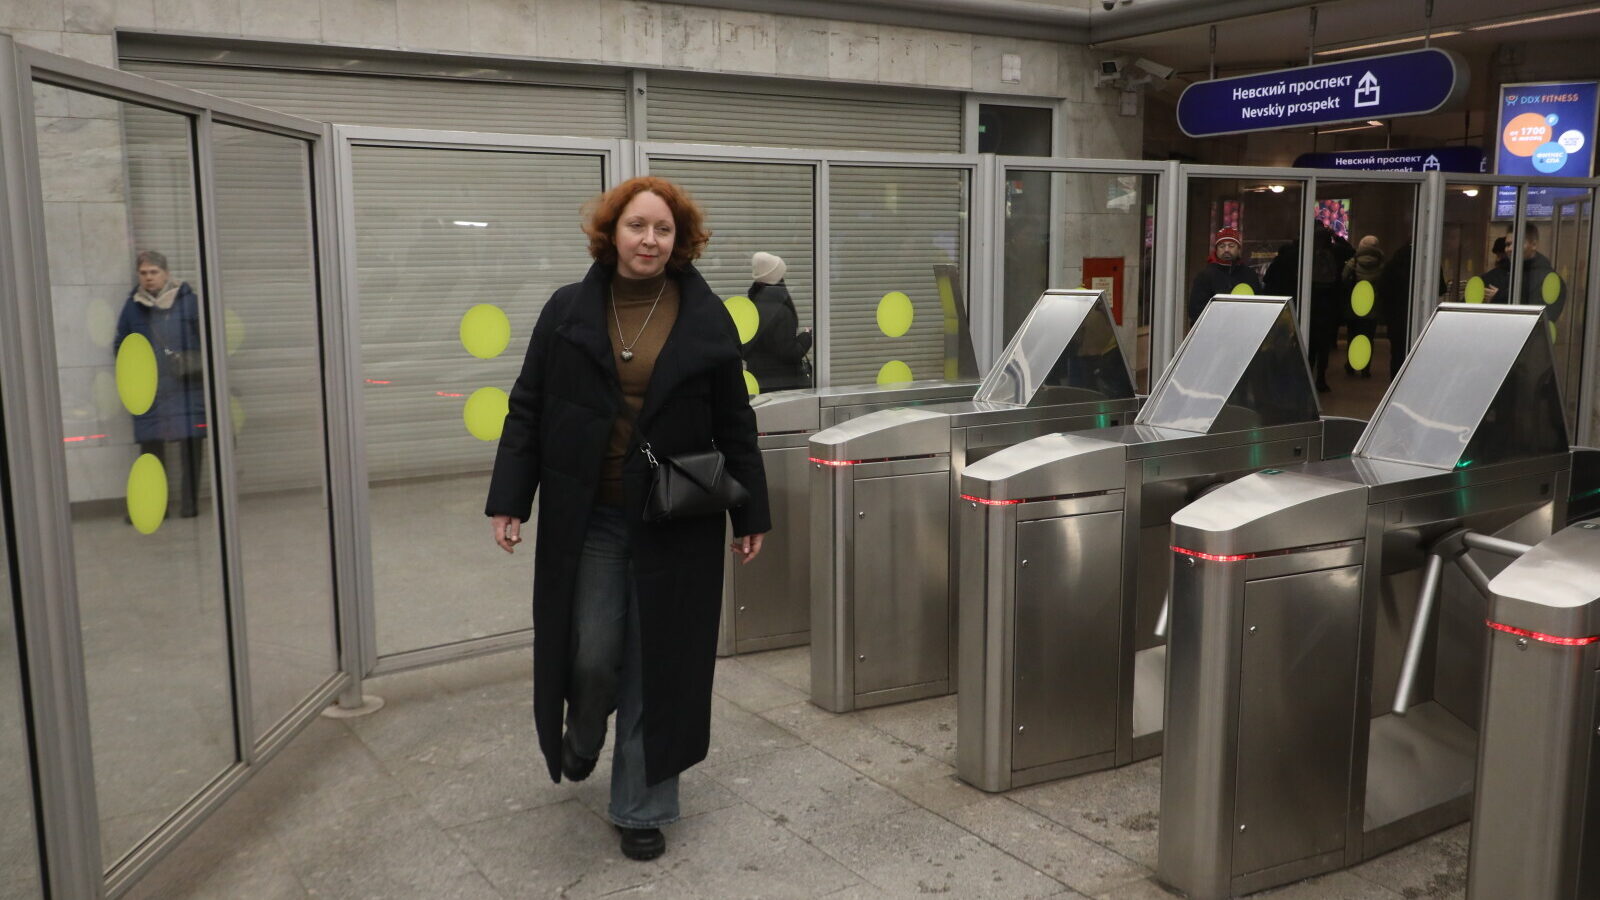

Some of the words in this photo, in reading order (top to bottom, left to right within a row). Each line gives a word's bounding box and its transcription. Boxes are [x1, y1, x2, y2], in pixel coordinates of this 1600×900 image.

[1232, 81, 1286, 101] Невский
[1288, 75, 1352, 96] проспект
[1520, 95, 1540, 104] DDX
[1541, 93, 1579, 103] FITNESS
[1241, 103, 1285, 118] Nevskiy
[1287, 96, 1340, 117] prospekt
[1521, 126, 1546, 136] 1700
[1335, 156, 1375, 165] Невский
[1377, 155, 1421, 165] проспект
